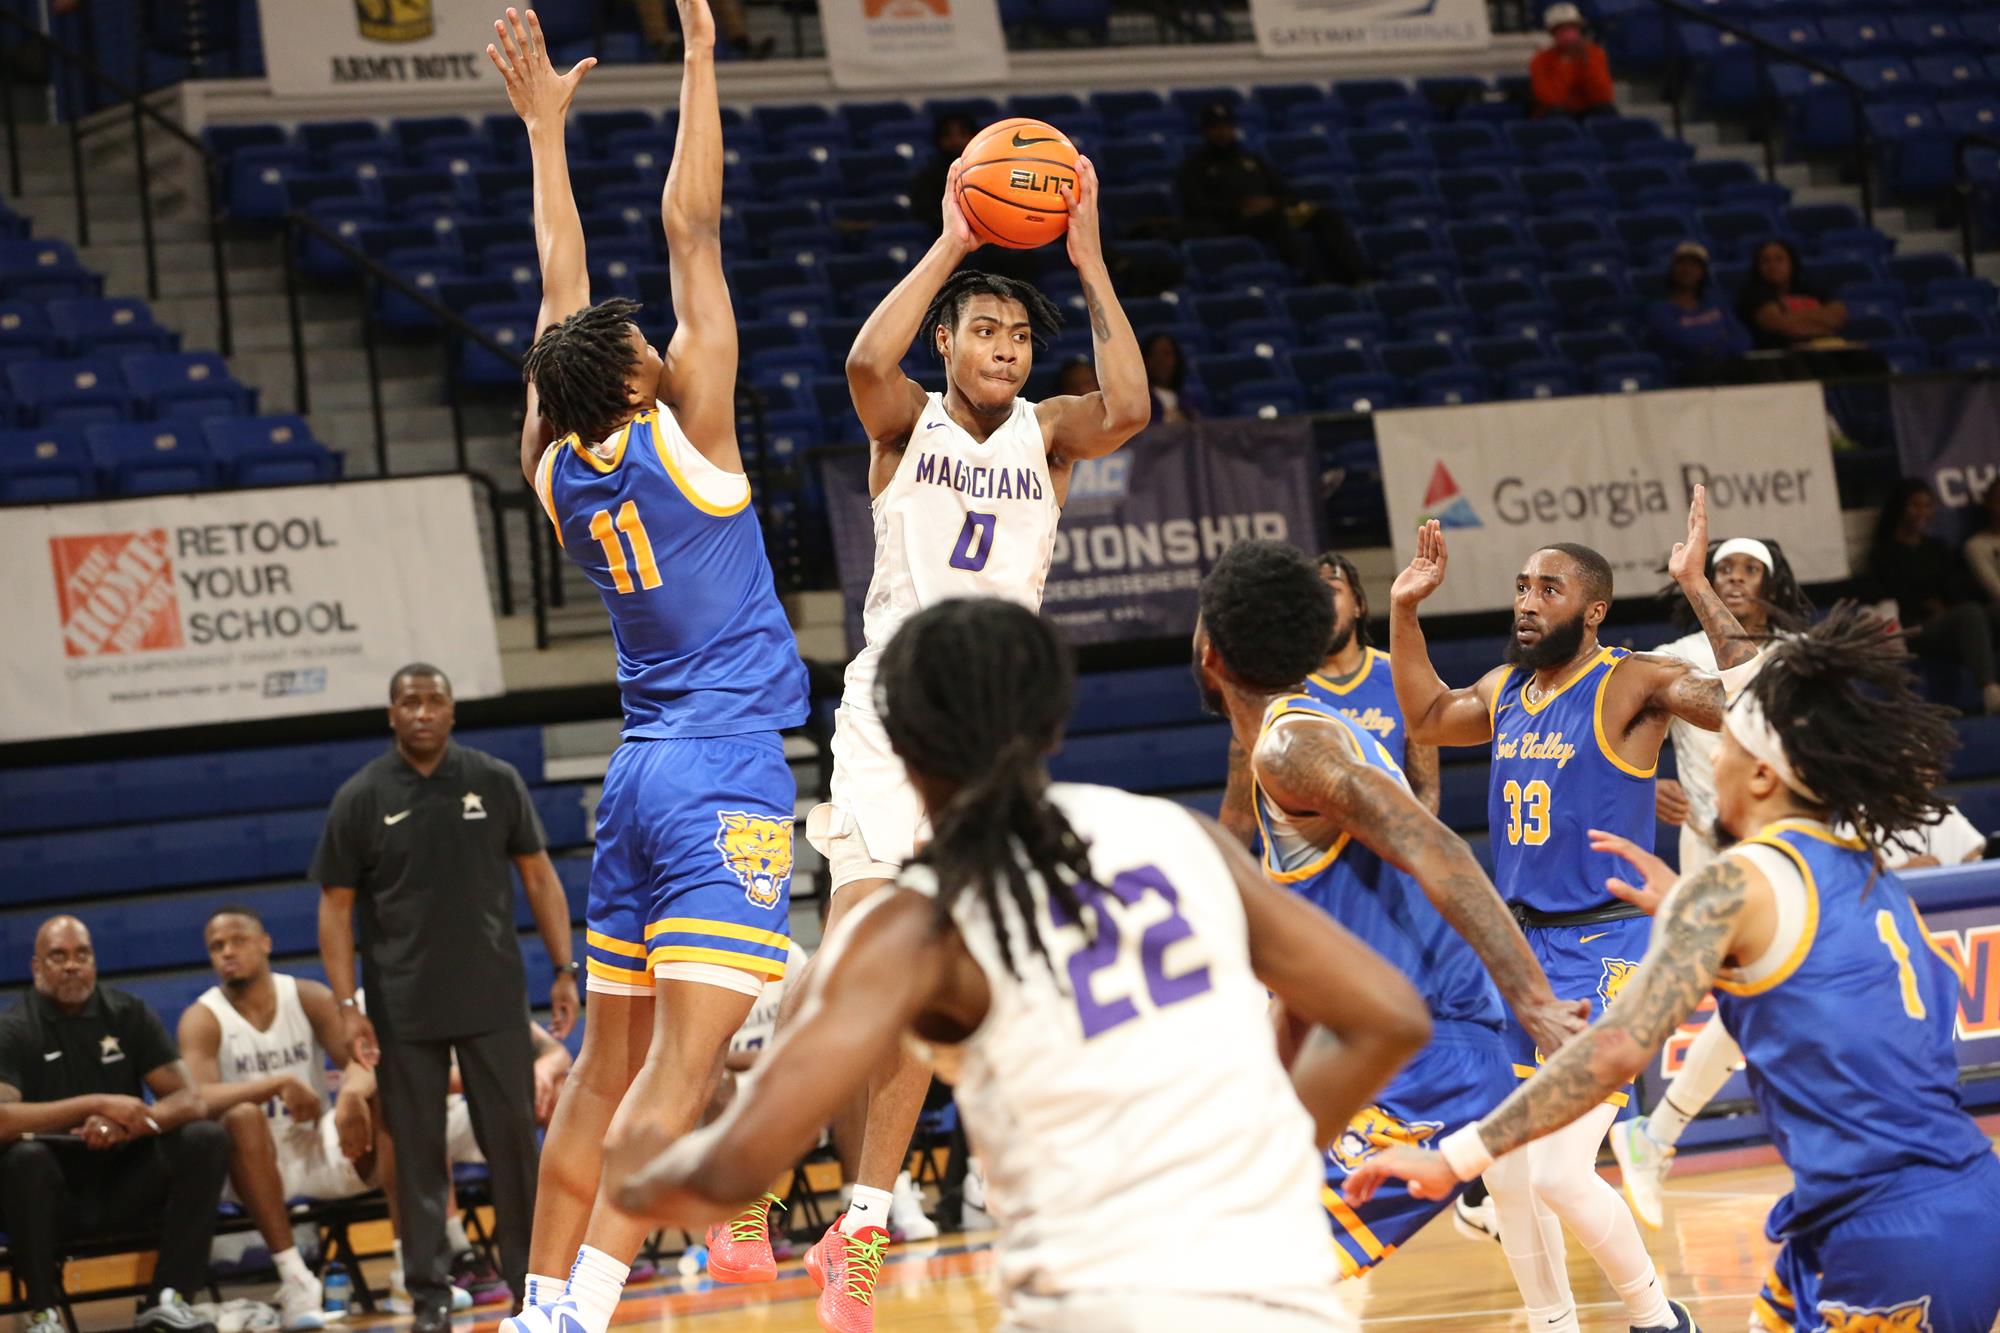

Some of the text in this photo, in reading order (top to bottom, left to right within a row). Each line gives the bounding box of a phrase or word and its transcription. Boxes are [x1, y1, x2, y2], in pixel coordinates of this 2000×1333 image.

[332, 52, 482, 84] ARMY ROTC
[916, 452, 1043, 500] MAGICIANS
[1493, 462, 1812, 528] Georgia Power
[177, 518, 338, 558] RETOOL
[589, 500, 663, 594] 11
[949, 511, 997, 572] 0
[1052, 511, 1288, 573] PIONSHIP
[181, 564, 293, 600] YOUR
[189, 602, 359, 645] SCHOOL
[1520, 732, 1576, 768] Valley
[1503, 780, 1551, 845] 33
[1049, 864, 1212, 1040] 22
[1875, 909, 1926, 1020] 1
